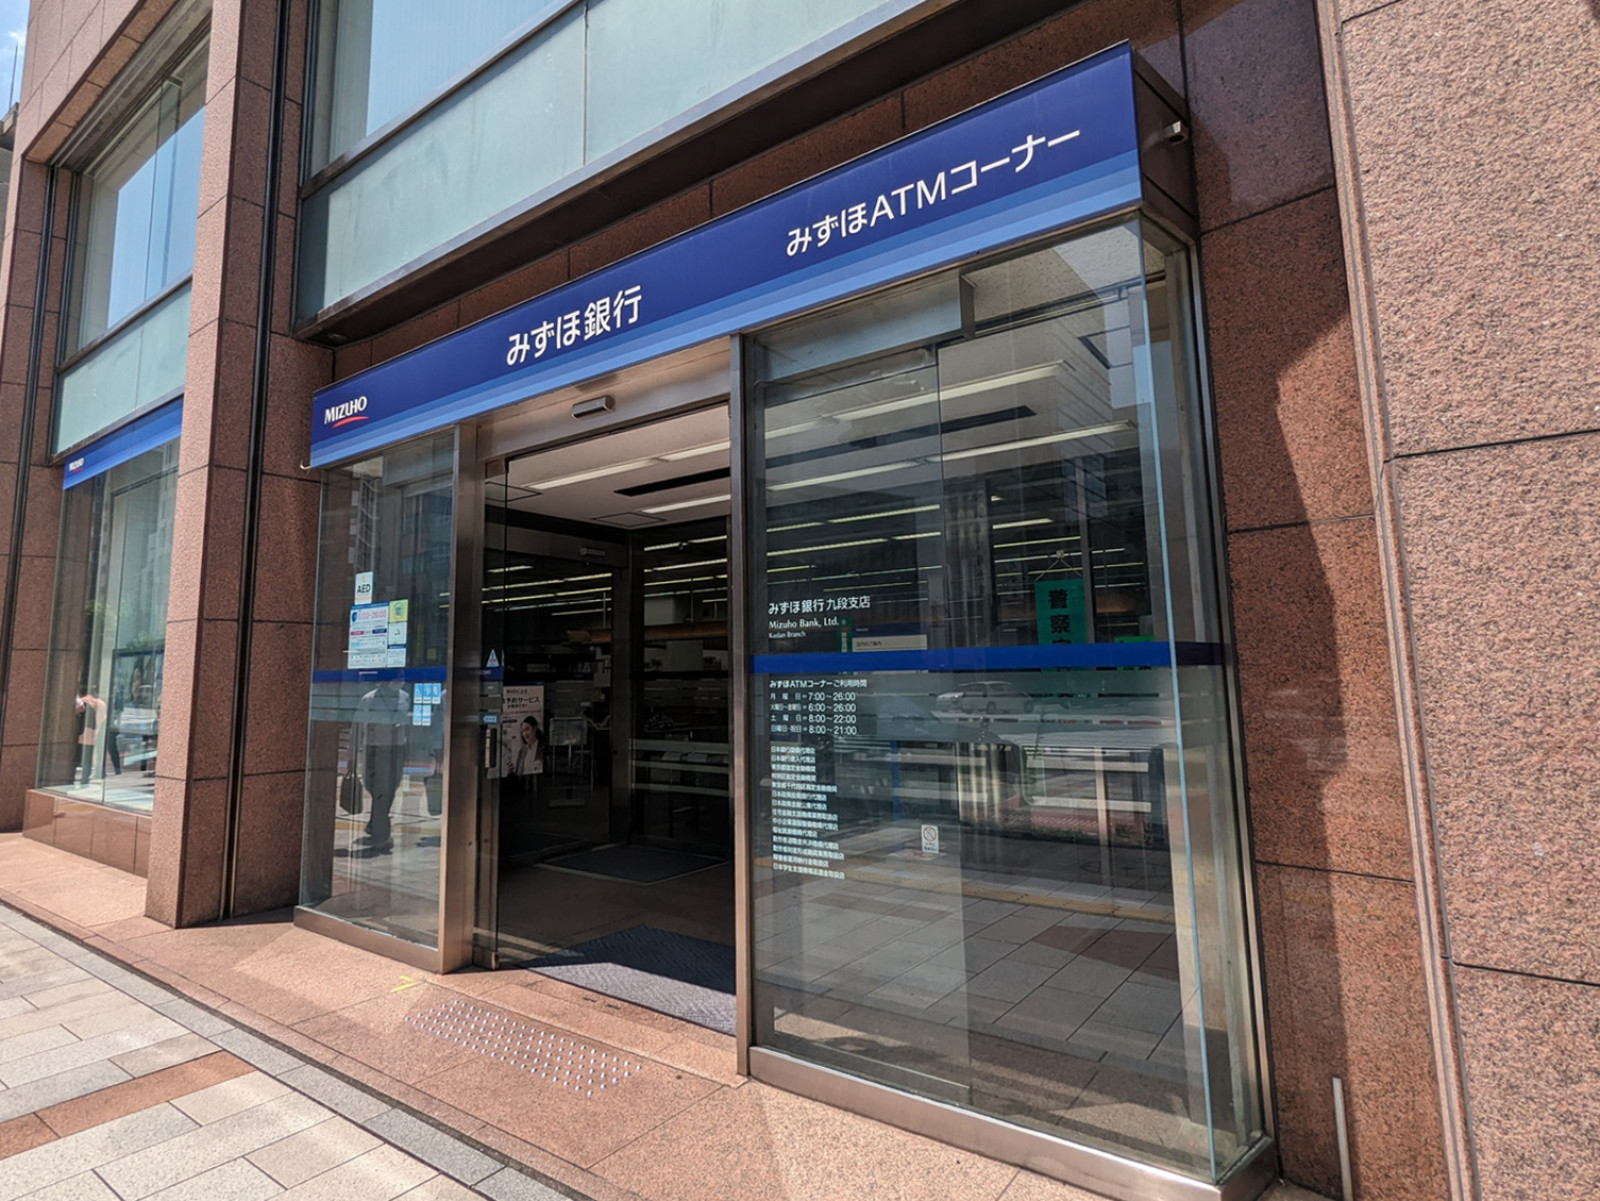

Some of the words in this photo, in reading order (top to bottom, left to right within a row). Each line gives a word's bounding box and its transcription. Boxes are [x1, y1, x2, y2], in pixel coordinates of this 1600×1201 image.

[786, 129, 1080, 256] みずほATMコーナー
[507, 285, 642, 366] みずほ銀行
[324, 396, 367, 425] MIZUHO
[356, 584, 371, 593] AED
[769, 620, 797, 630] Mizuho
[800, 618, 821, 628] Bank,
[824, 616, 839, 626] Ltd.
